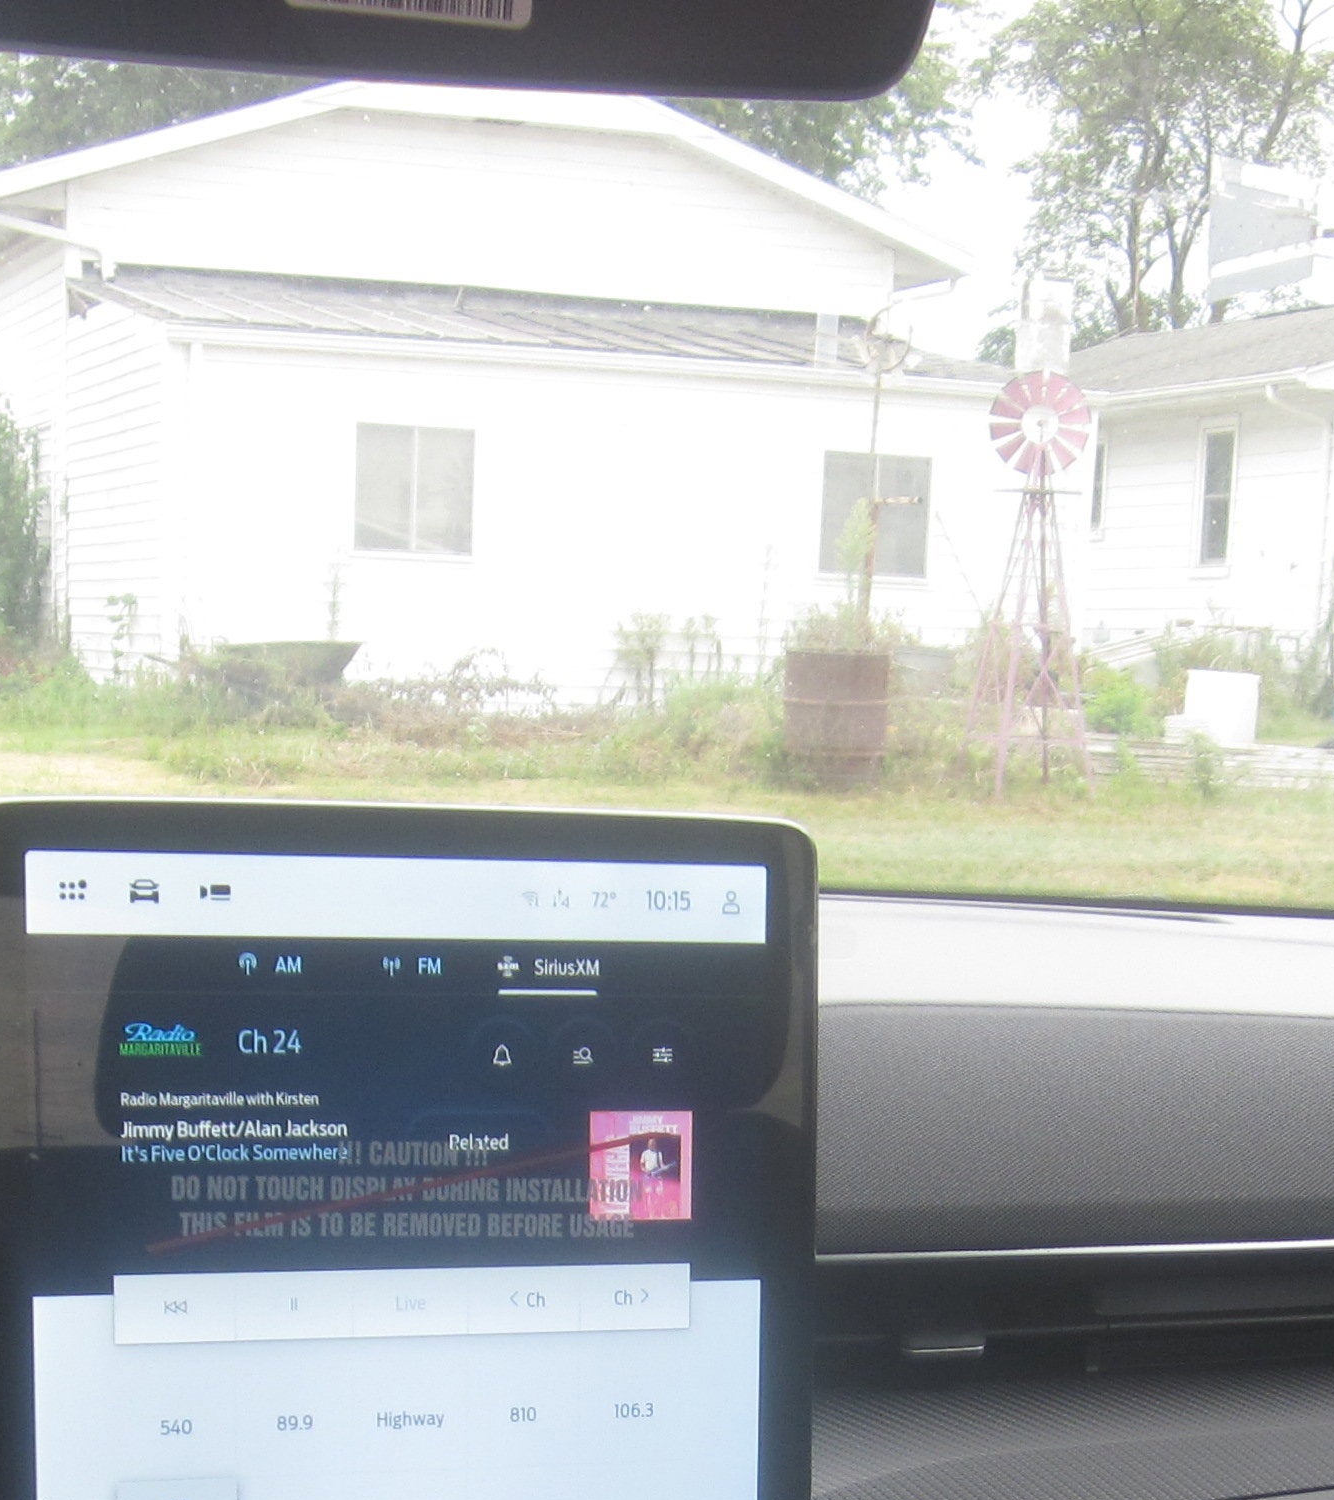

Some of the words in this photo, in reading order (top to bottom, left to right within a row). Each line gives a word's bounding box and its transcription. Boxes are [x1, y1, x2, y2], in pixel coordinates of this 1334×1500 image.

[646, 890, 691, 911] 10:15
[275, 956, 302, 973] AM
[418, 958, 442, 975] FM
[533, 958, 600, 976] SiriusXM
[124, 1022, 196, 1042] Radio
[238, 1029, 267, 1053] Ch
[273, 1029, 302, 1054] 24
[120, 1092, 157, 1106] Radio
[158, 1092, 244, 1108] Margaritaville
[247, 1092, 274, 1106] with
[276, 1092, 319, 1105] Kirsten
[120, 1121, 174, 1141] Jimmy
[177, 1120, 282, 1138] Buffett/Alan
[284, 1120, 348, 1137] Jackson
[449, 1133, 510, 1150] Related
[121, 1146, 148, 1162] It's
[151, 1145, 184, 1162] Five
[188, 1144, 249, 1161] O'Clock
[252, 1143, 348, 1160] Somewhere
[370, 1141, 459, 1166] CAUTION
[171, 1175, 200, 1200] DO
[207, 1175, 249, 1200] NOT
[255, 1175, 324, 1200] TOUCH
[330, 1175, 416, 1202] DISPLAY
[423, 1177, 499, 1202] DURING
[505, 1177, 643, 1203] INSTALLATION
[179, 1212, 227, 1237] THIS
[234, 1212, 283, 1237] FILM
[291, 1212, 311, 1237] IS
[319, 1212, 343, 1237] TO
[350, 1212, 376, 1237] BE
[383, 1213, 481, 1237] REMOVED
[488, 1213, 564, 1238] BEFORE
[570, 1213, 635, 1238] USAGE
[526, 1292, 546, 1308] Ch
[614, 1290, 633, 1305] Ch
[510, 1407, 537, 1422] 810
[614, 1403, 654, 1418] 106.3
[160, 1419, 193, 1435] 540
[277, 1415, 314, 1431] 89.9
[376, 1410, 445, 1430] Highway
